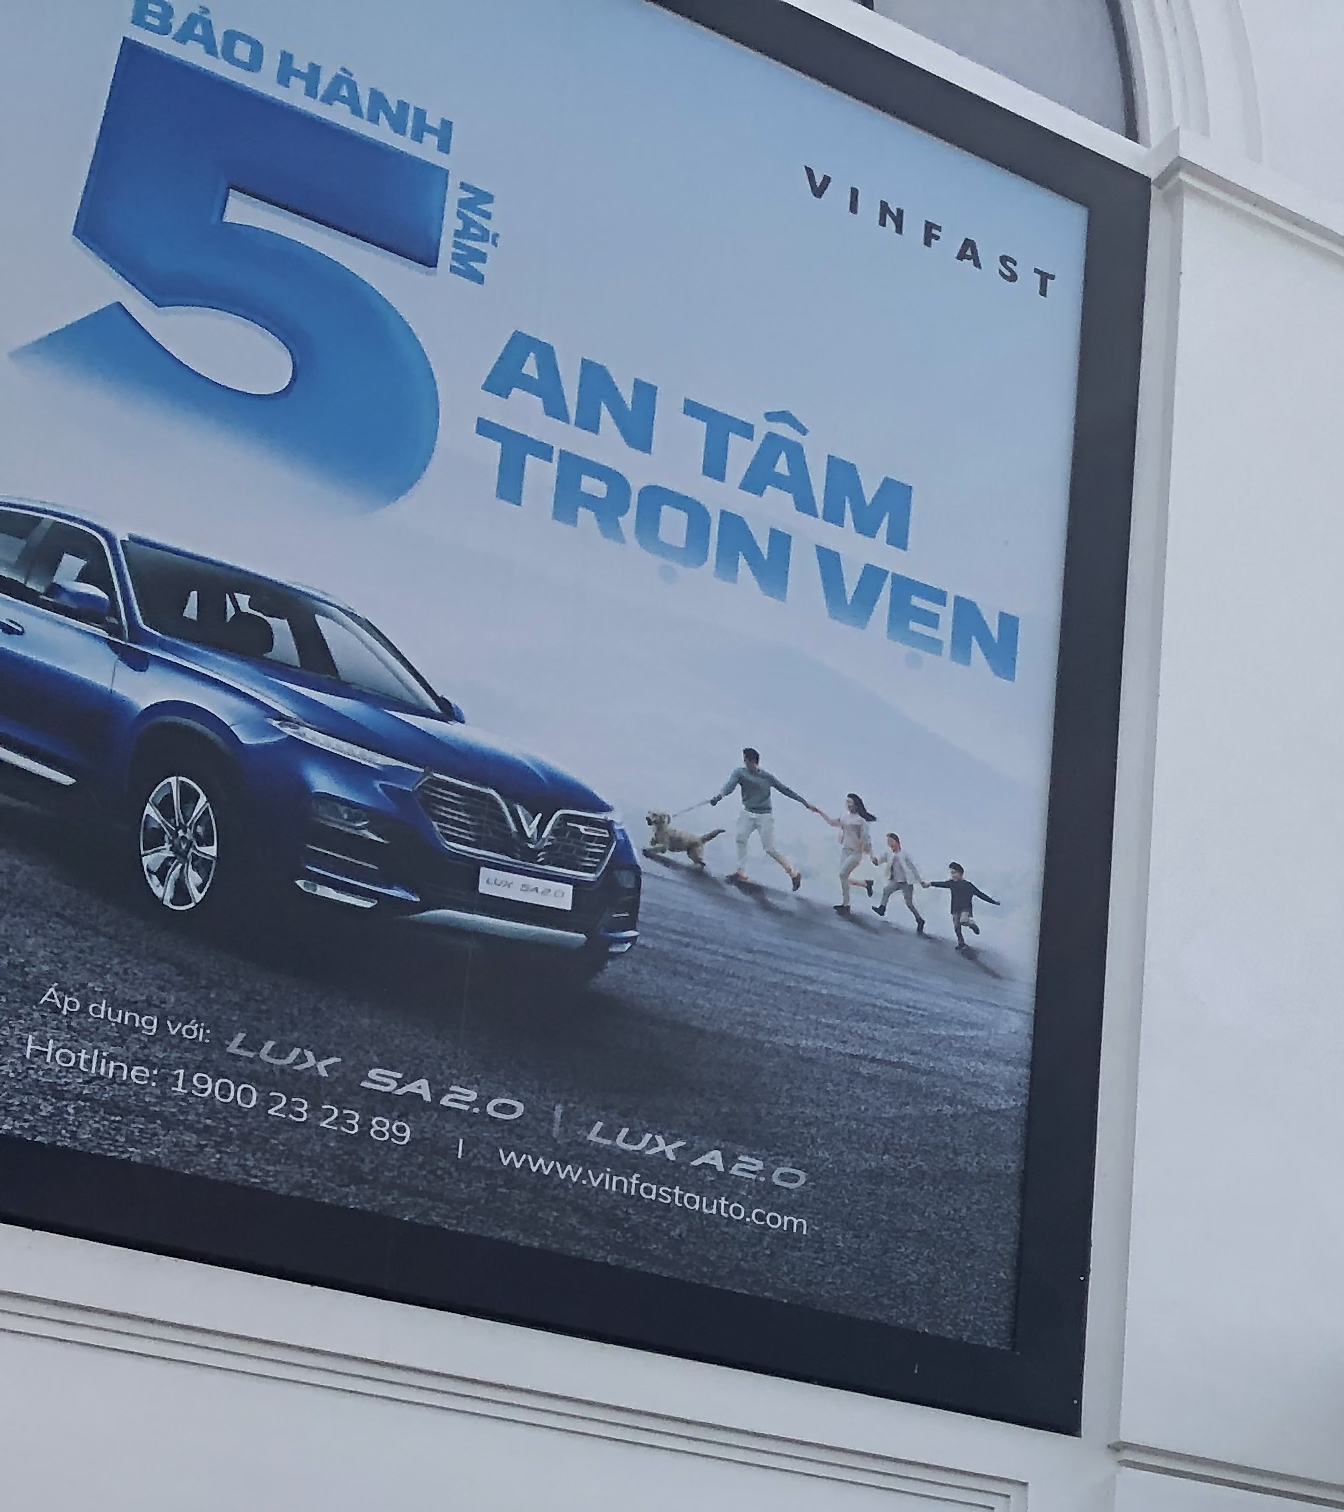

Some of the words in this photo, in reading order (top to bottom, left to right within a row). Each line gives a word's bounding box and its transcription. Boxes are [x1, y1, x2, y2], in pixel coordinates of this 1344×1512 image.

[130, 0, 264, 73] BẢO
[277, 50, 454, 154] HÀNH
[8, 37, 449, 515] 5
[449, 181, 500, 286] NĂM
[803, 165, 1056, 298] VINFAST
[481, 330, 658, 455] AN
[683, 398, 913, 551] TÂM
[475, 416, 793, 602] TRỌN
[815, 544, 1020, 682] VẸN
[25, 1035, 159, 1088] Hotline:
[171, 1068, 258, 1110] 1900
[267, 1091, 308, 1122] 23
[319, 1104, 360, 1135] 23
[369, 1116, 412, 1146] 89
[499, 1147, 809, 1235] www.vinfastauto.com
[39, 983, 81, 1016] Áp
[88, 998, 159, 1036] dụng
[226, 1032, 342, 1078] LUX
[360, 1068, 525, 1121] SA2.0
[586, 1120, 686, 1161] LUX
